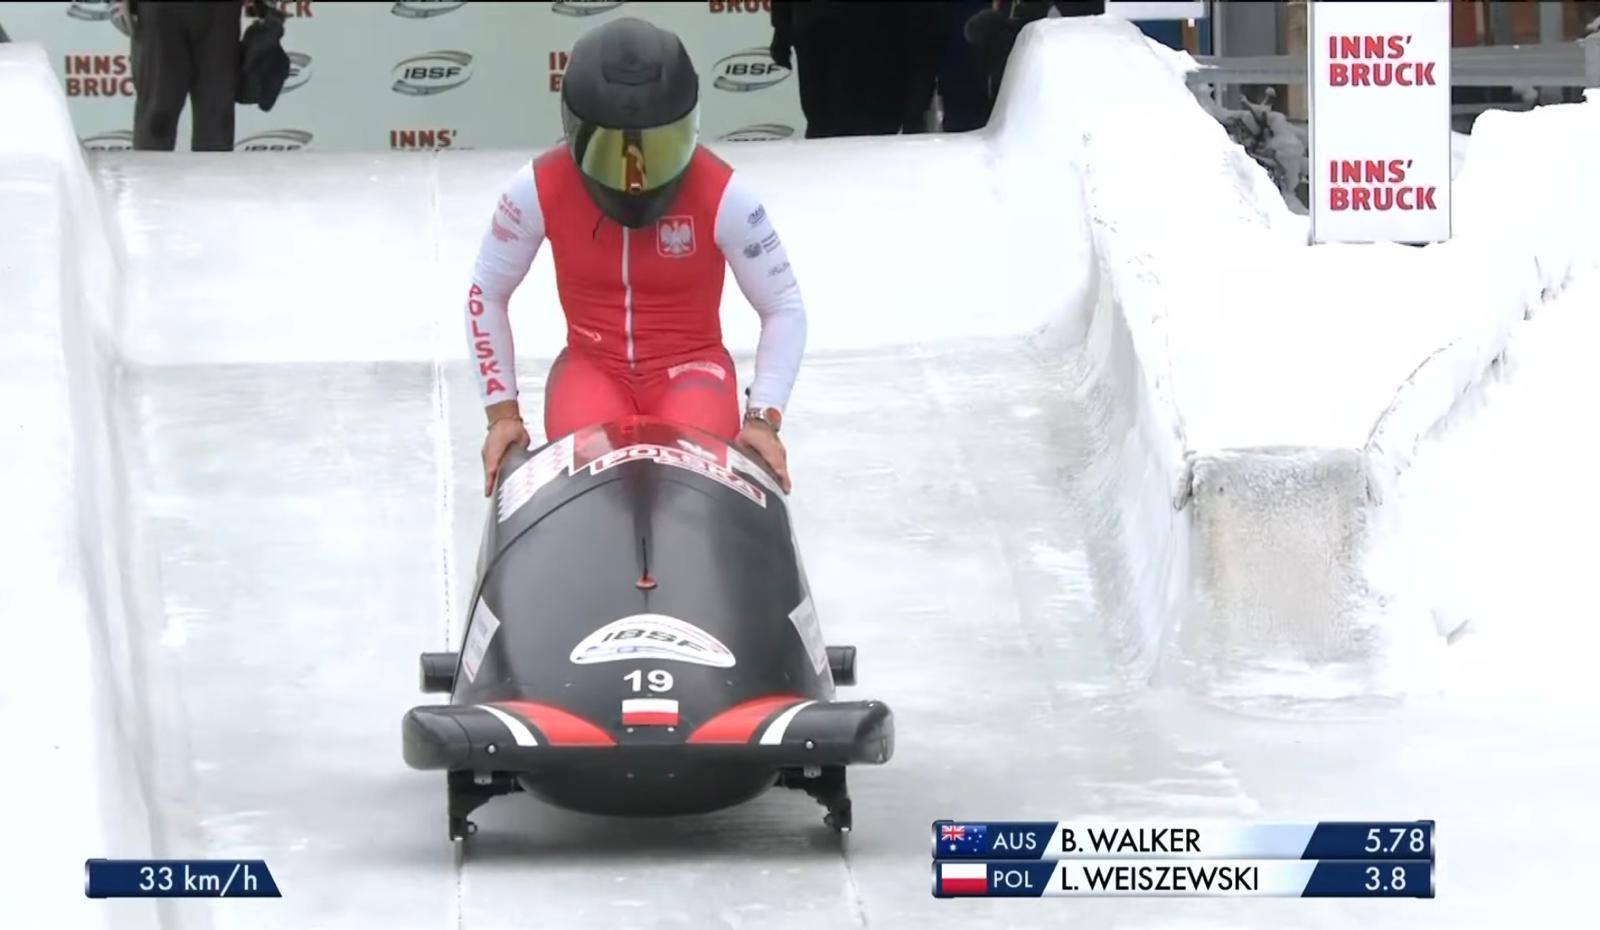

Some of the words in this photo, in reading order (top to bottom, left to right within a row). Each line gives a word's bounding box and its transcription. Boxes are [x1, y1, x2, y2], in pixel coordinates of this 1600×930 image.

[1329, 35, 1412, 59] INNS'
[404, 66, 461, 79] IBSF
[725, 63, 780, 75] IBSF
[1329, 62, 1436, 87] BRUCK
[66, 77, 134, 97] BRUC
[390, 129, 457, 148] INNS'
[1330, 160, 1413, 183] INNS'
[1330, 186, 1437, 211] BRUCK
[469, 283, 506, 395] POLSKA
[602, 447, 760, 498] POLSKA
[602, 629, 706, 652] IBSF
[623, 669, 674, 692] 19
